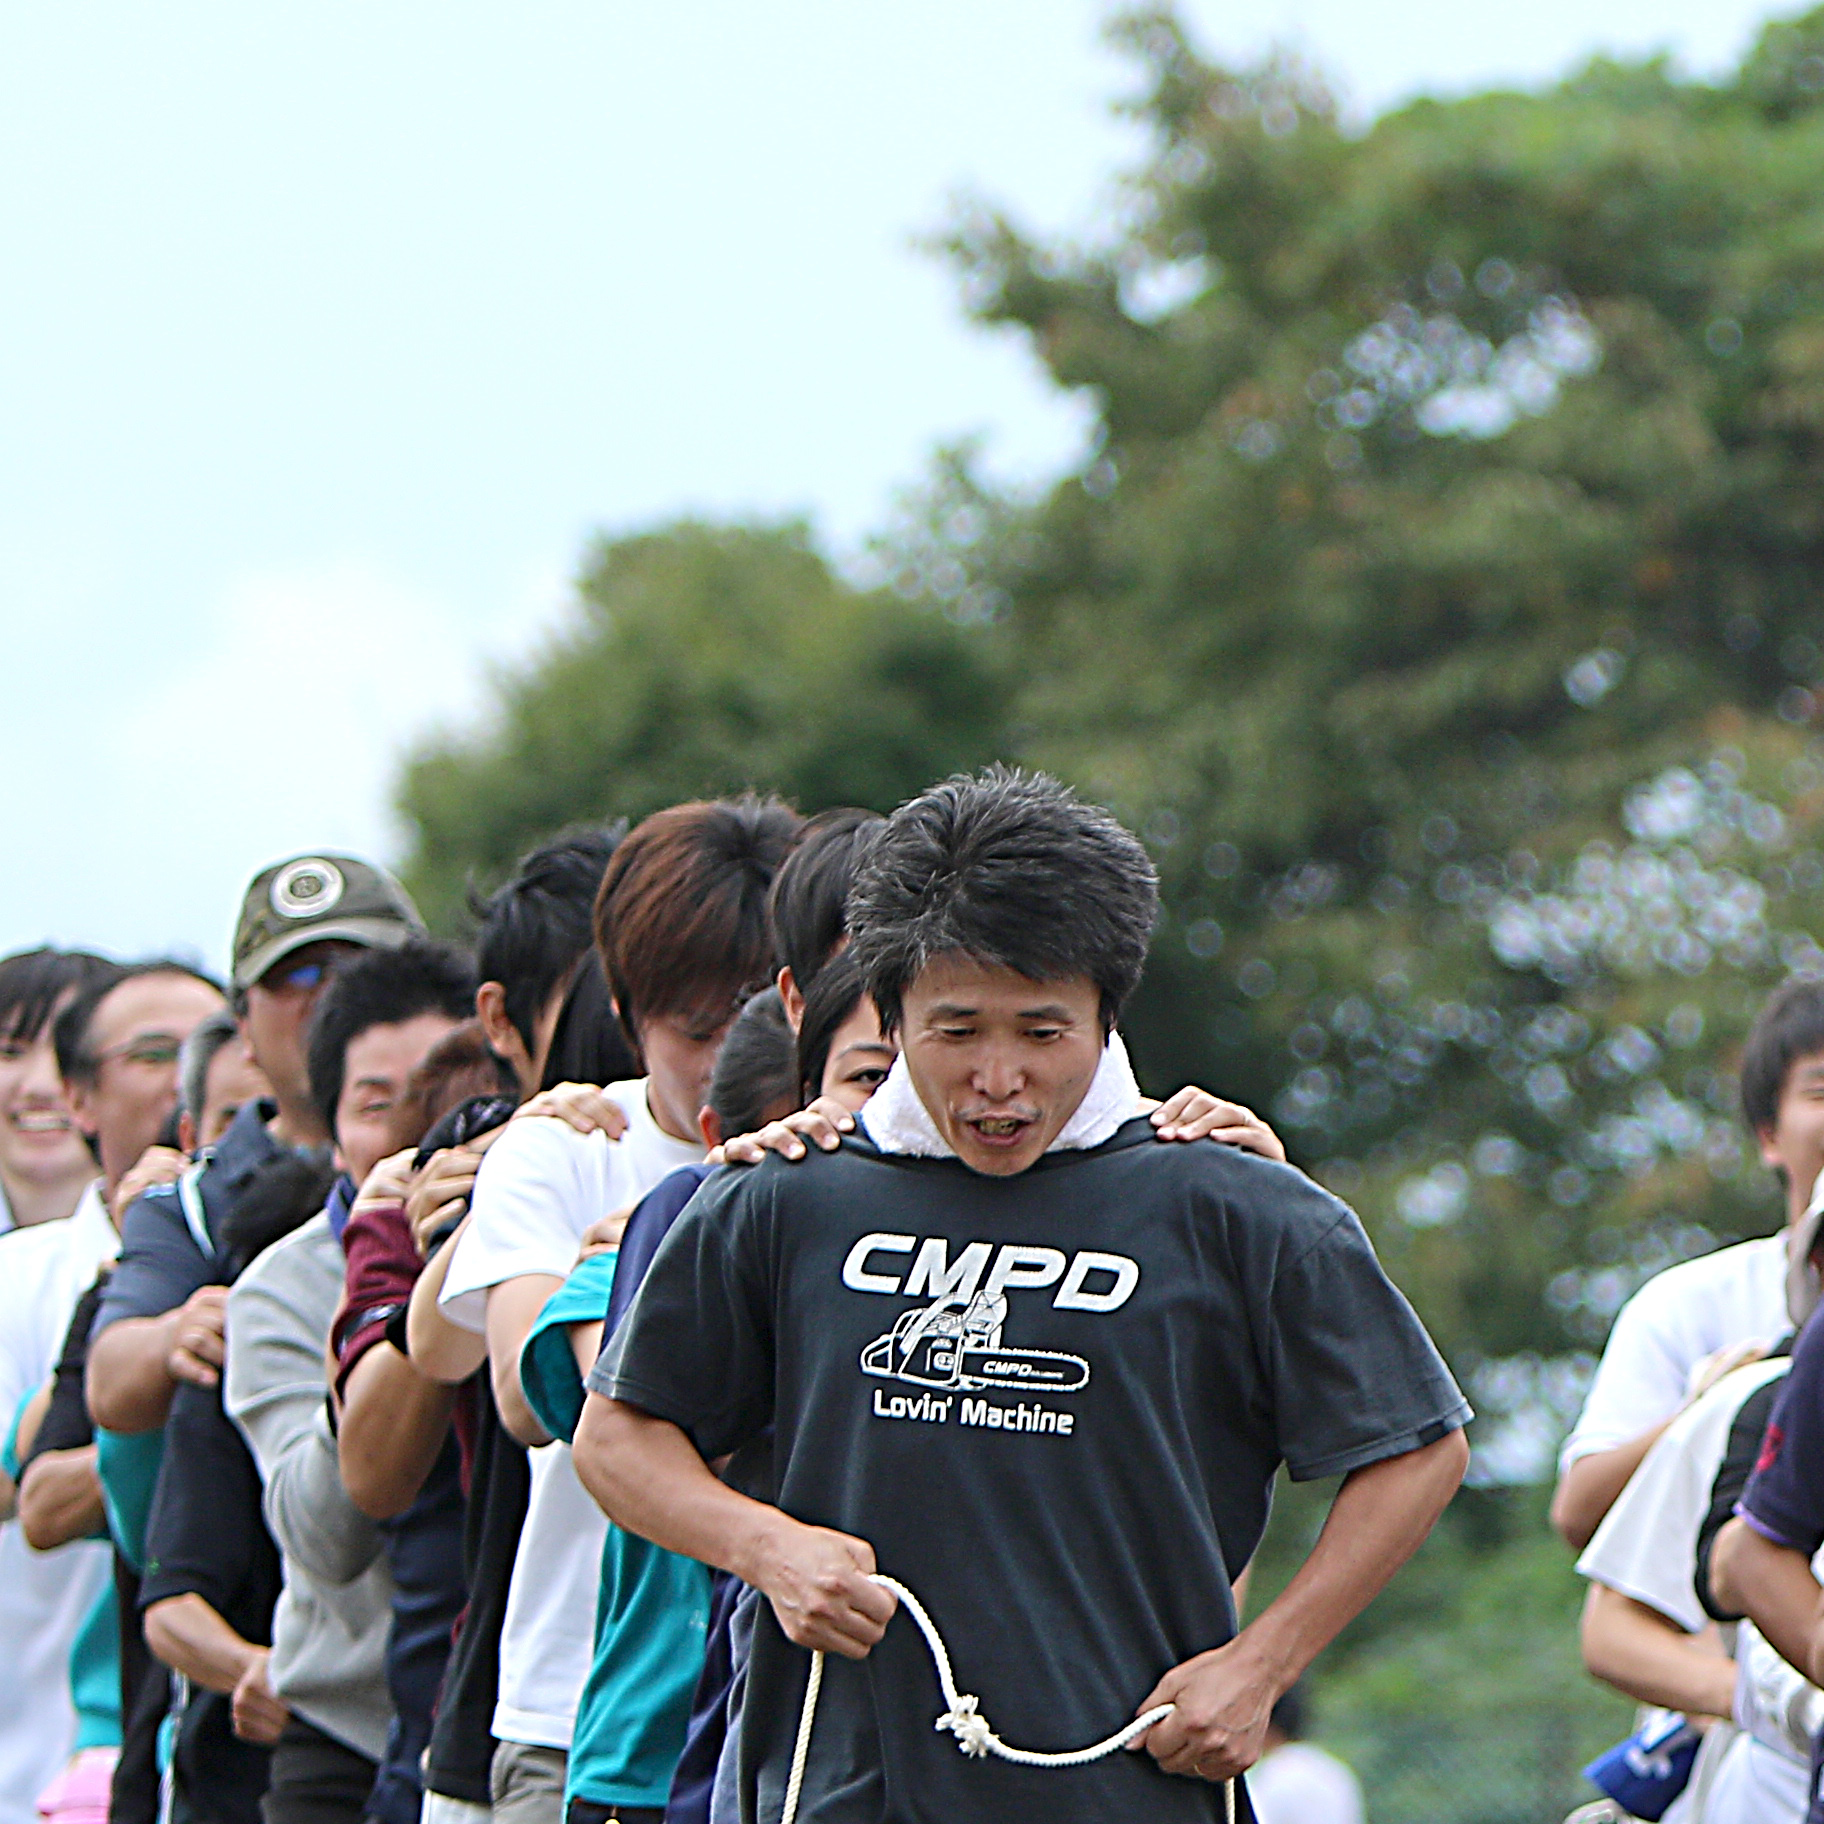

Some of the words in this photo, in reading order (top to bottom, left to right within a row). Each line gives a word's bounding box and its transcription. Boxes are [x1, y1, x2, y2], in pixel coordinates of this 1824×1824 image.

[842, 1233, 1139, 1312] CMPD
[983, 1361, 1032, 1377] CMPD
[874, 1390, 952, 1423] Lovin'
[961, 1398, 1074, 1435] Machine
